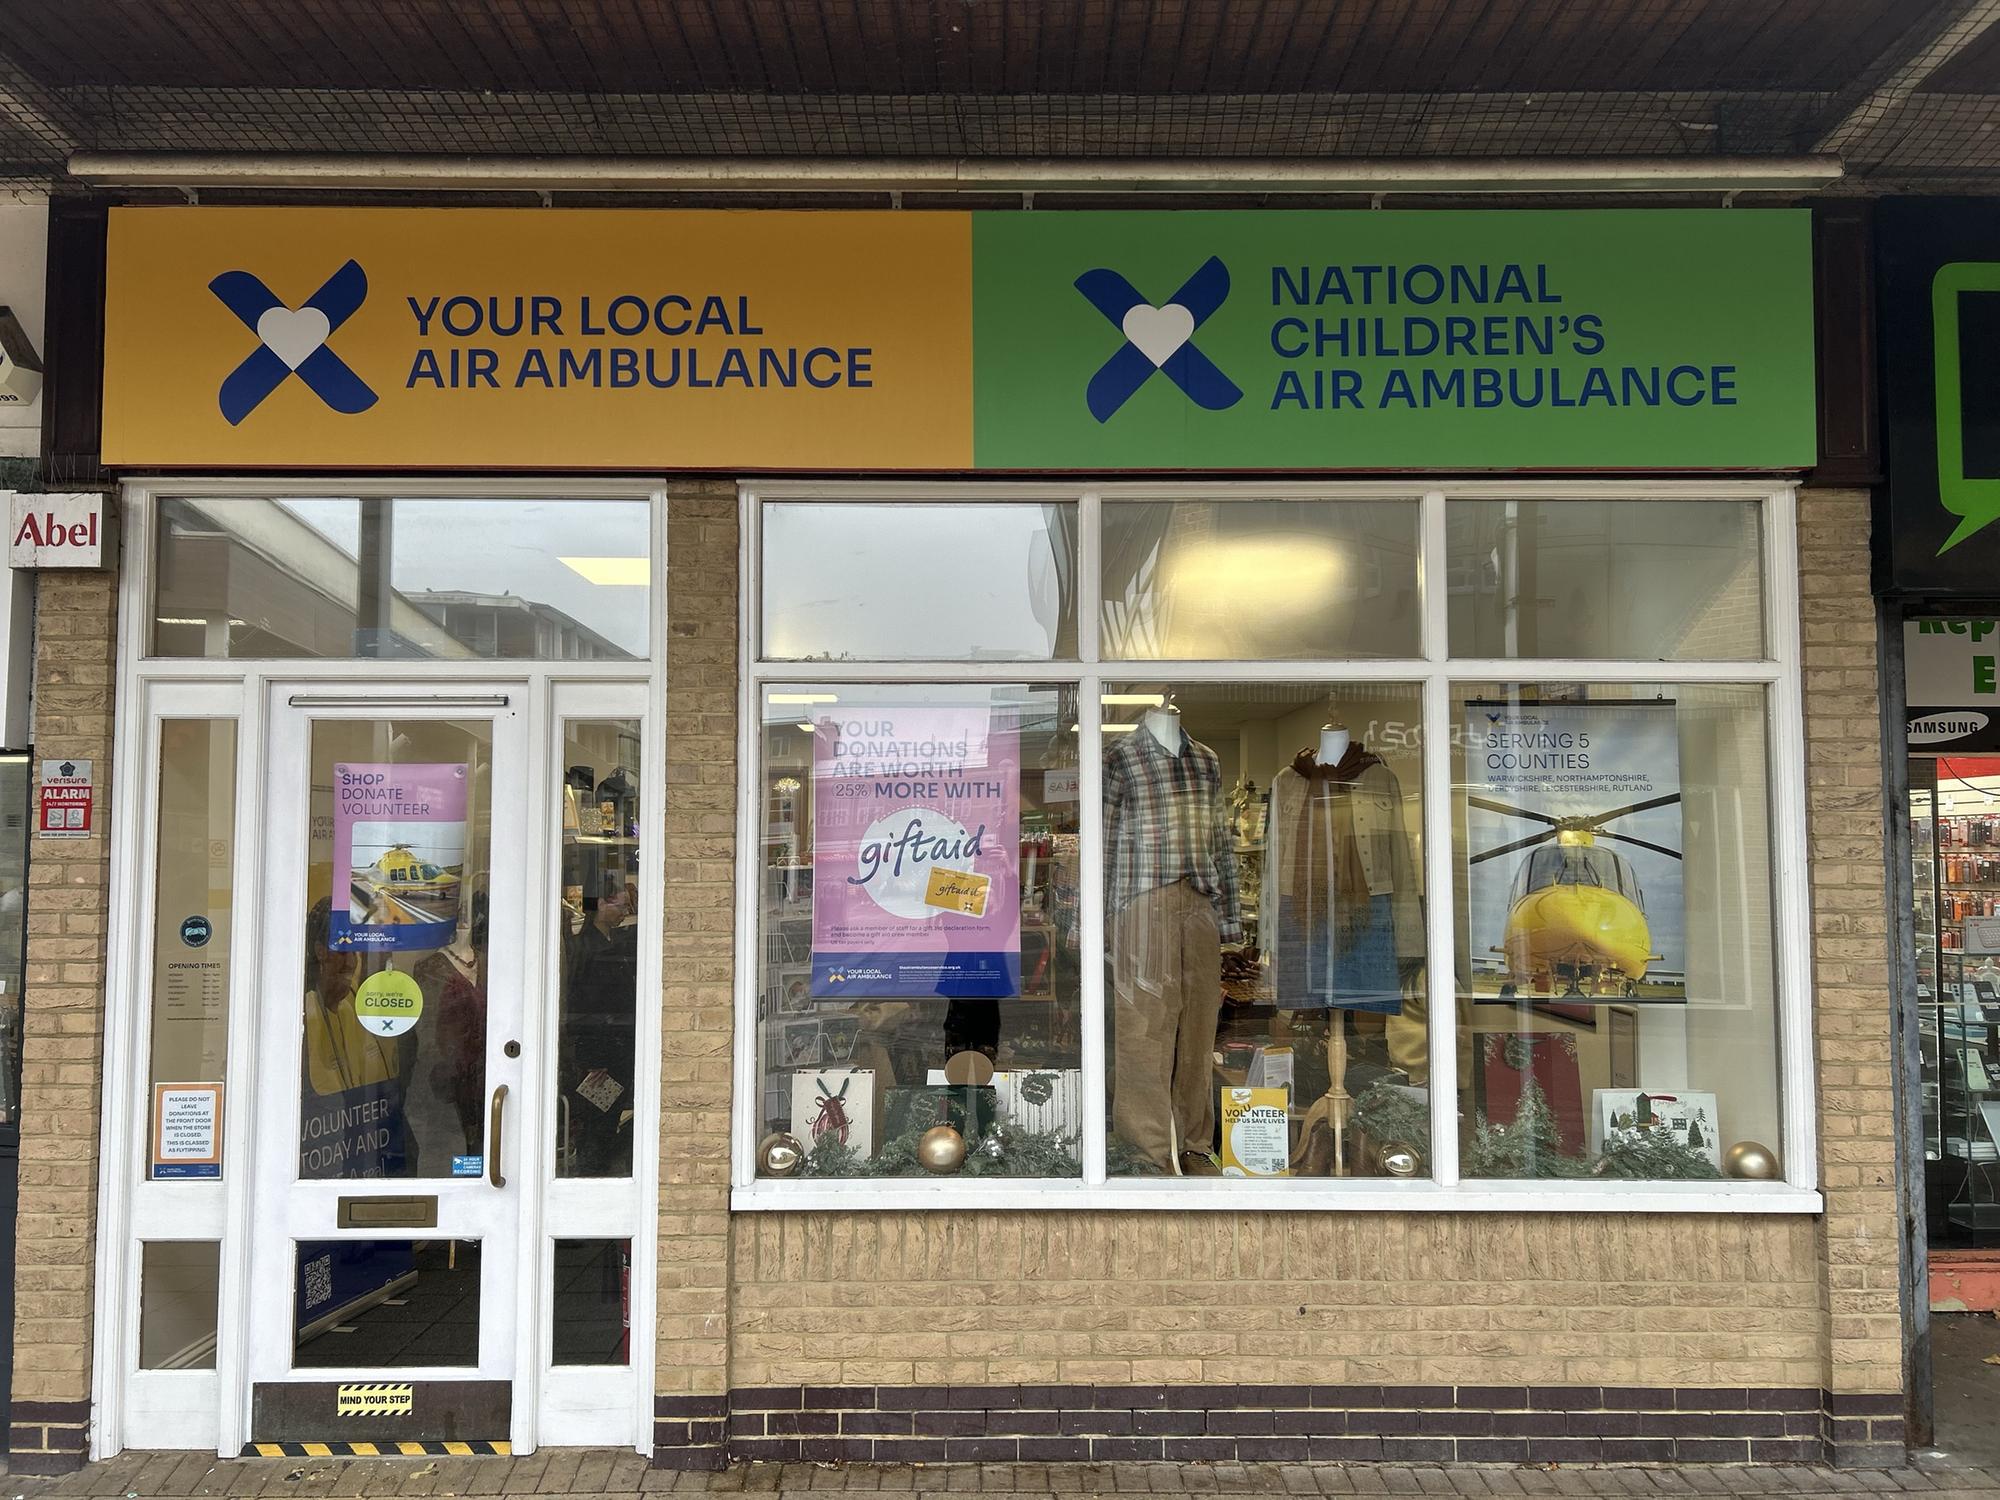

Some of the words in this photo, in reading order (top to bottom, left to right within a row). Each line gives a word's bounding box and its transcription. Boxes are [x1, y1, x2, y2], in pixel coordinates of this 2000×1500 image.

[1272, 264, 1562, 306] NATIONAL
[406, 296, 564, 336] YOUR
[581, 294, 763, 336] LOCAL
[1270, 314, 1605, 358] CHILDREN'S
[406, 348, 500, 388] AIR
[514, 347, 873, 388] AMBULANCE
[1271, 370, 1364, 410] AIR
[1379, 365, 1737, 408] AMBULANCE
[14, 512, 97, 547] Abel
[1973, 656, 1996, 694] E
[834, 720, 894, 738] YOUR
[1906, 722, 1979, 734] SAMSUNG
[1486, 732, 1573, 748] SERVING
[1578, 732, 1590, 748] 5
[833, 741, 968, 758] DONATIONS
[832, 762, 876, 778] ARE
[881, 761, 962, 778] WORTH
[1486, 754, 1590, 769] COUNTIES
[342, 774, 384, 786] SHOP
[1488, 774, 1555, 782] WARWICKSHIRE,
[1556, 774, 1650, 782] NORTHAMPTONSHIRE,
[44, 788, 90, 799] ALARM
[342, 788, 403, 800] DONATE
[835, 783, 868, 798] 25%
[875, 782, 938, 798] MORE
[944, 782, 1001, 798] WITH
[1612, 784, 1653, 792] RUTLAND
[342, 804, 430, 815] VOLUNTEER
[365, 998, 414, 1008] CLOSED
[301, 1138, 352, 1174] TODAY
[356, 1128, 390, 1156] AND
[340, 1396, 362, 1404] MIND
[364, 1396, 387, 1404] YOUR
[389, 1395, 410, 1404] STEP
